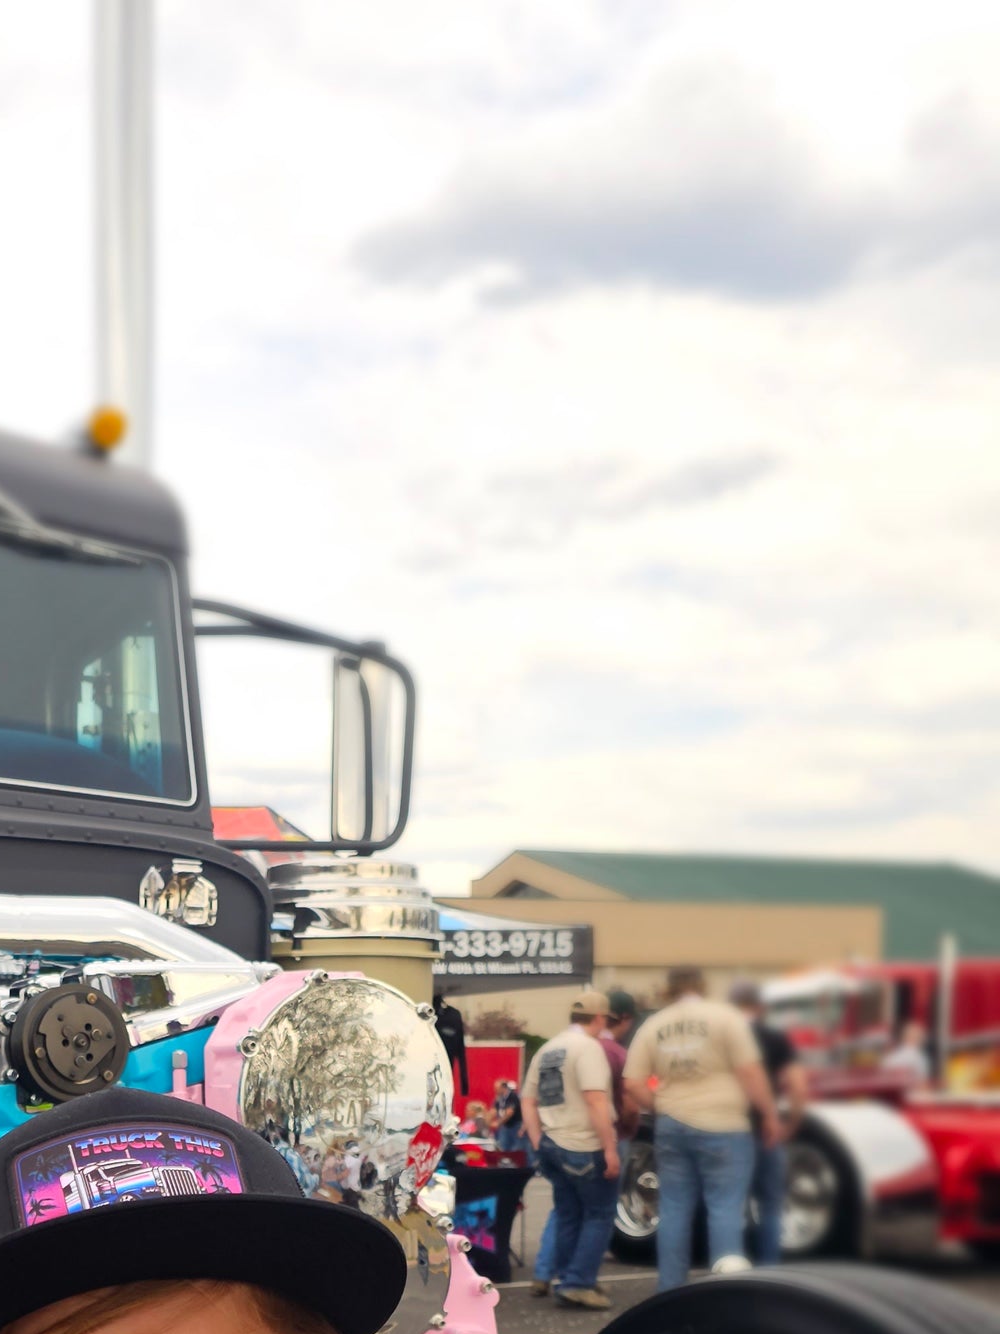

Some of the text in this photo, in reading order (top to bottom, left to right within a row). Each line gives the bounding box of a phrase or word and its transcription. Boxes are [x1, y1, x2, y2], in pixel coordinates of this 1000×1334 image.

[334, 1096, 371, 1125] CAT
[75, 1132, 224, 1158] TRUCK THIS
